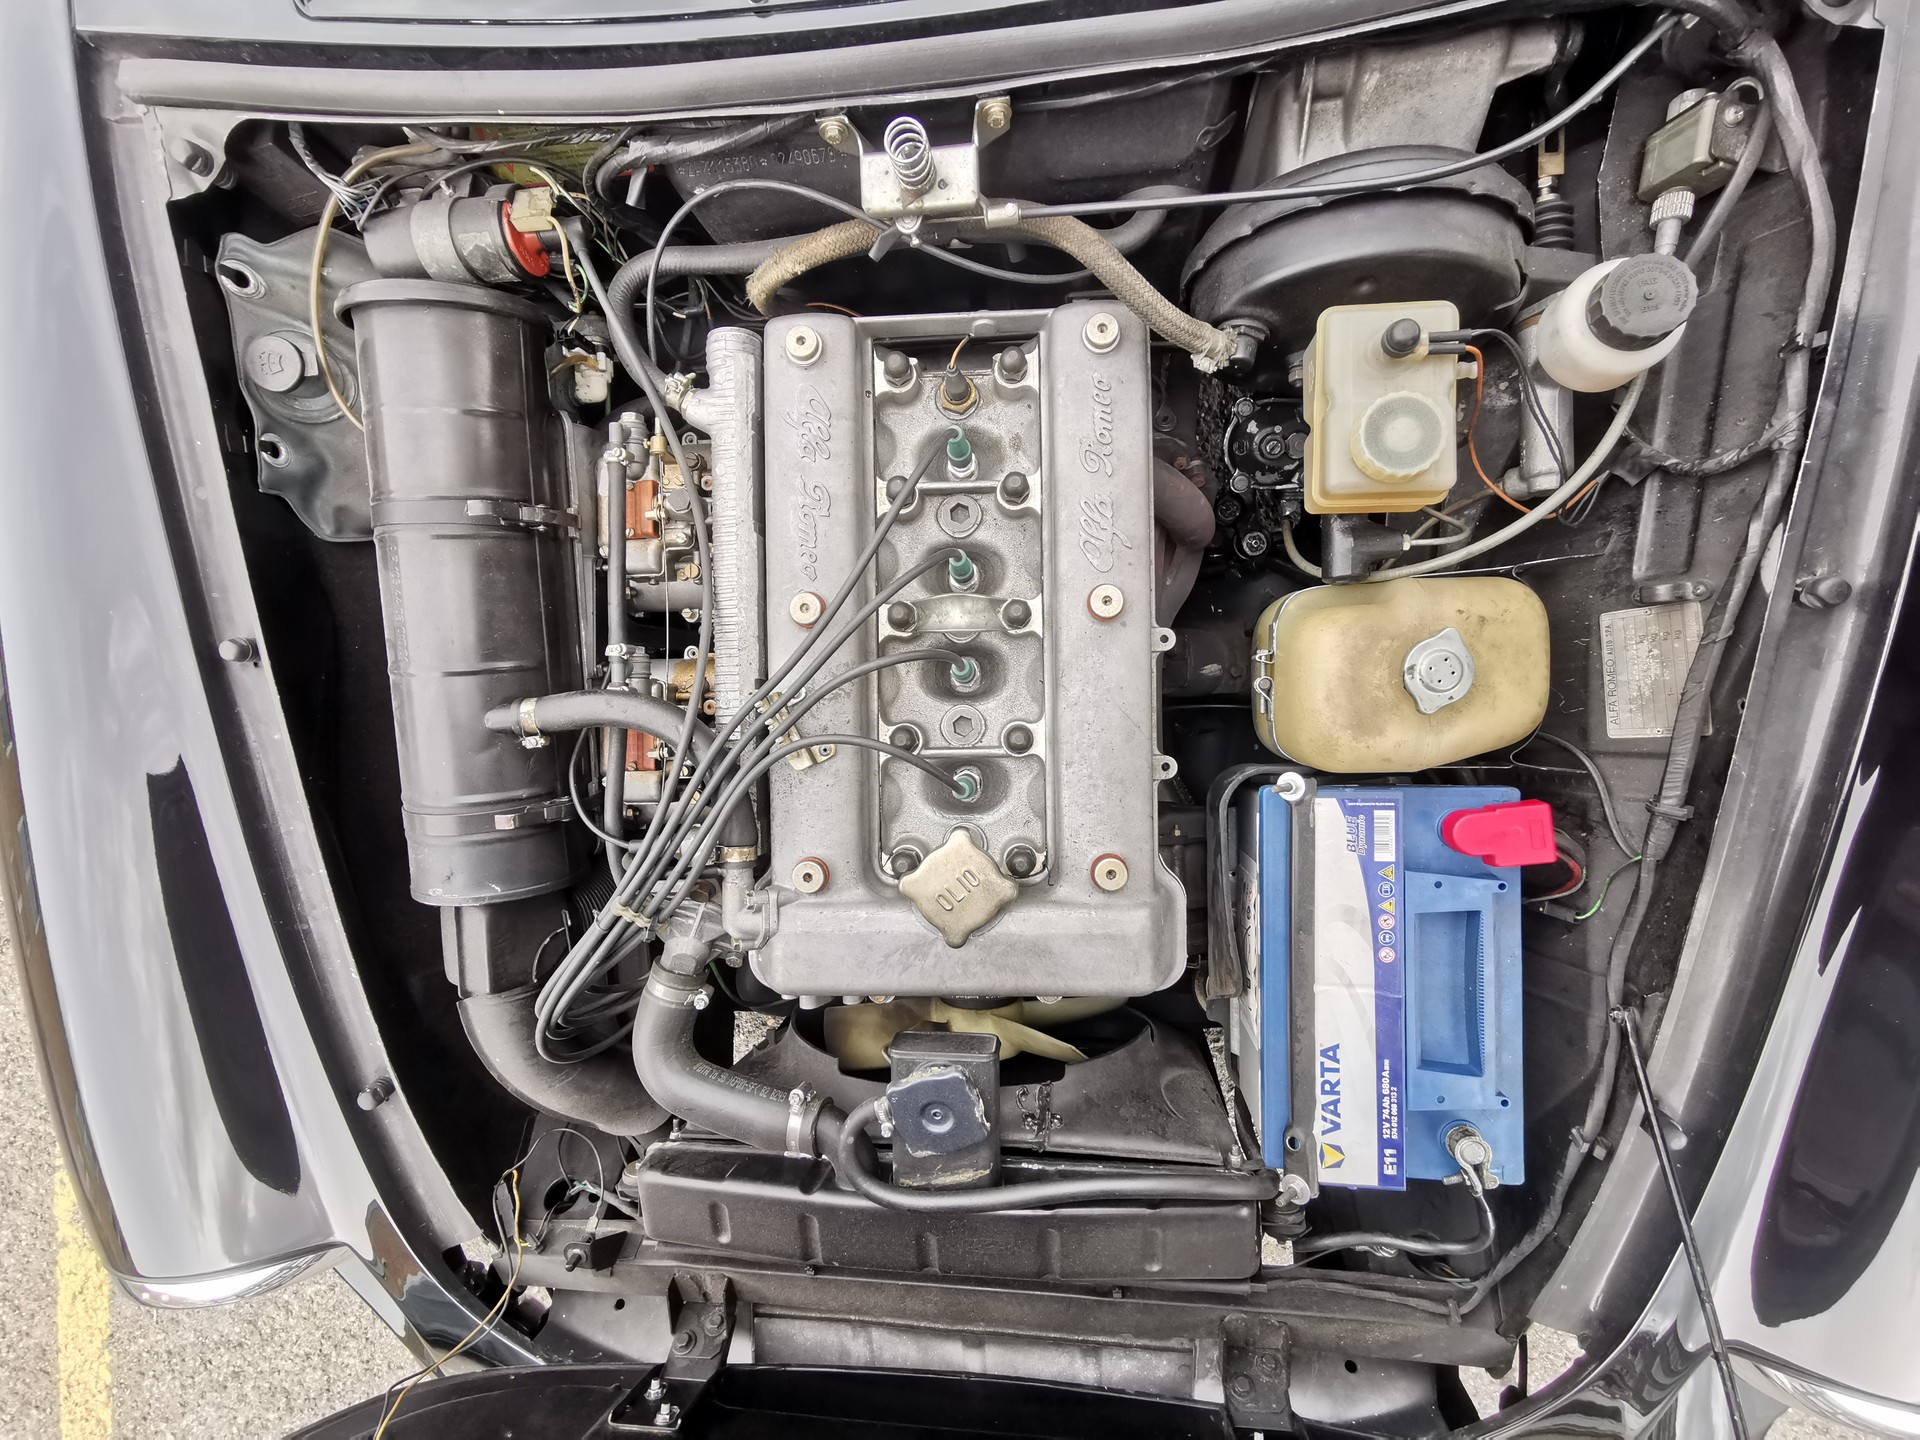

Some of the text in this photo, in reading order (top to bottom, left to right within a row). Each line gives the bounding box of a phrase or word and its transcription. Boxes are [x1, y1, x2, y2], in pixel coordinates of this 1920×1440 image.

[780, 384, 832, 582] Alfa Romeo
[1079, 371, 1132, 573] Alfa Romeo
[1605, 639, 1614, 656] AUTO
[1637, 634, 1646, 644] kg
[1660, 631, 1670, 642] kg
[1672, 629, 1682, 640] kg
[1605, 658, 1617, 697] ROMEO
[1608, 699, 1620, 726] ALFA
[1345, 815, 1357, 853] BLUE
[1357, 814, 1367, 856] Dynamic
[936, 868, 980, 911] OLIO
[1319, 1043, 1341, 1136] VARTA
[1382, 1096, 1390, 1120] 74Ah
[1382, 1121, 1390, 1139] 12V
[1383, 1148, 1397, 1175] E11
